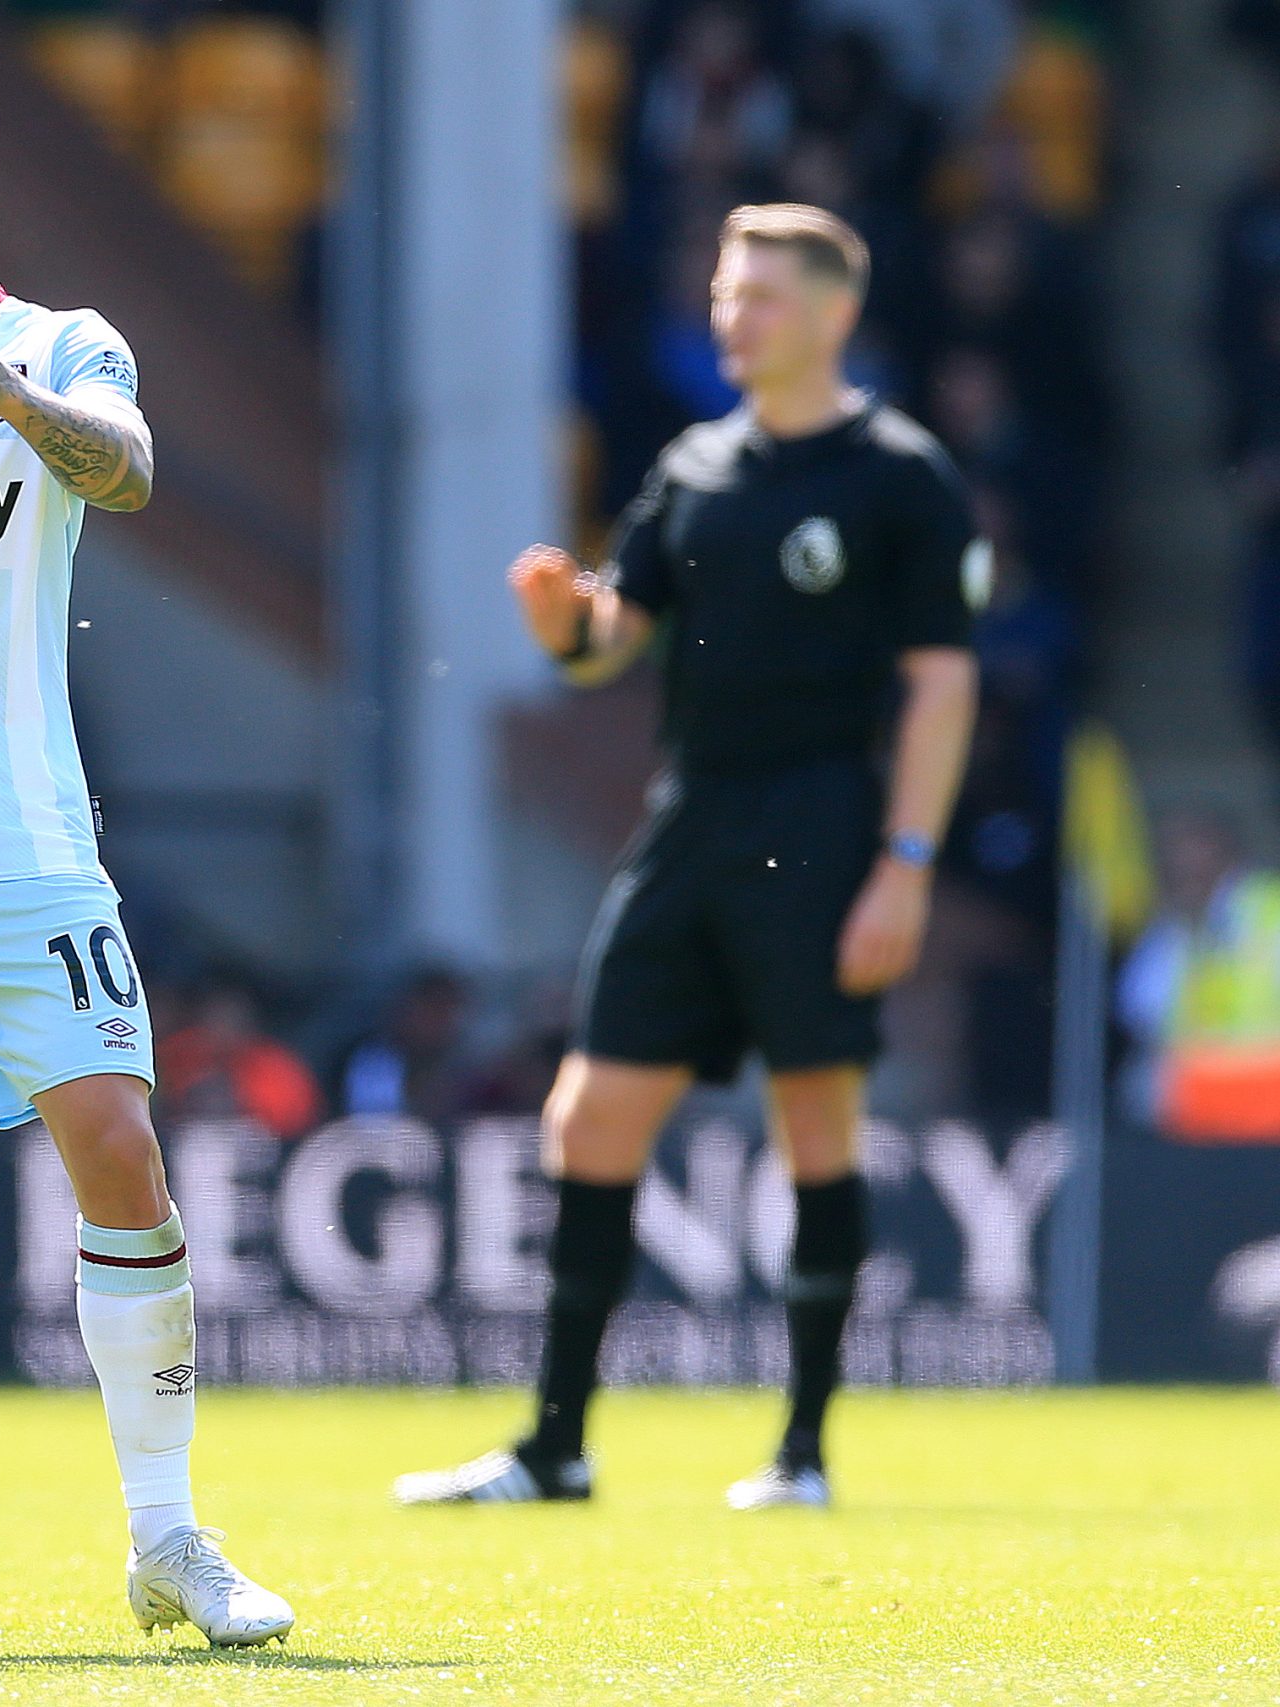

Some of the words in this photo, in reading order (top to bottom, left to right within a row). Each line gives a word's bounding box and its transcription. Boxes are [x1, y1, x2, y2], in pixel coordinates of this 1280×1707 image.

[46, 924, 139, 1012] 10
[103, 1039, 136, 1051] umbro
[155, 1385, 193, 1396] umbr
